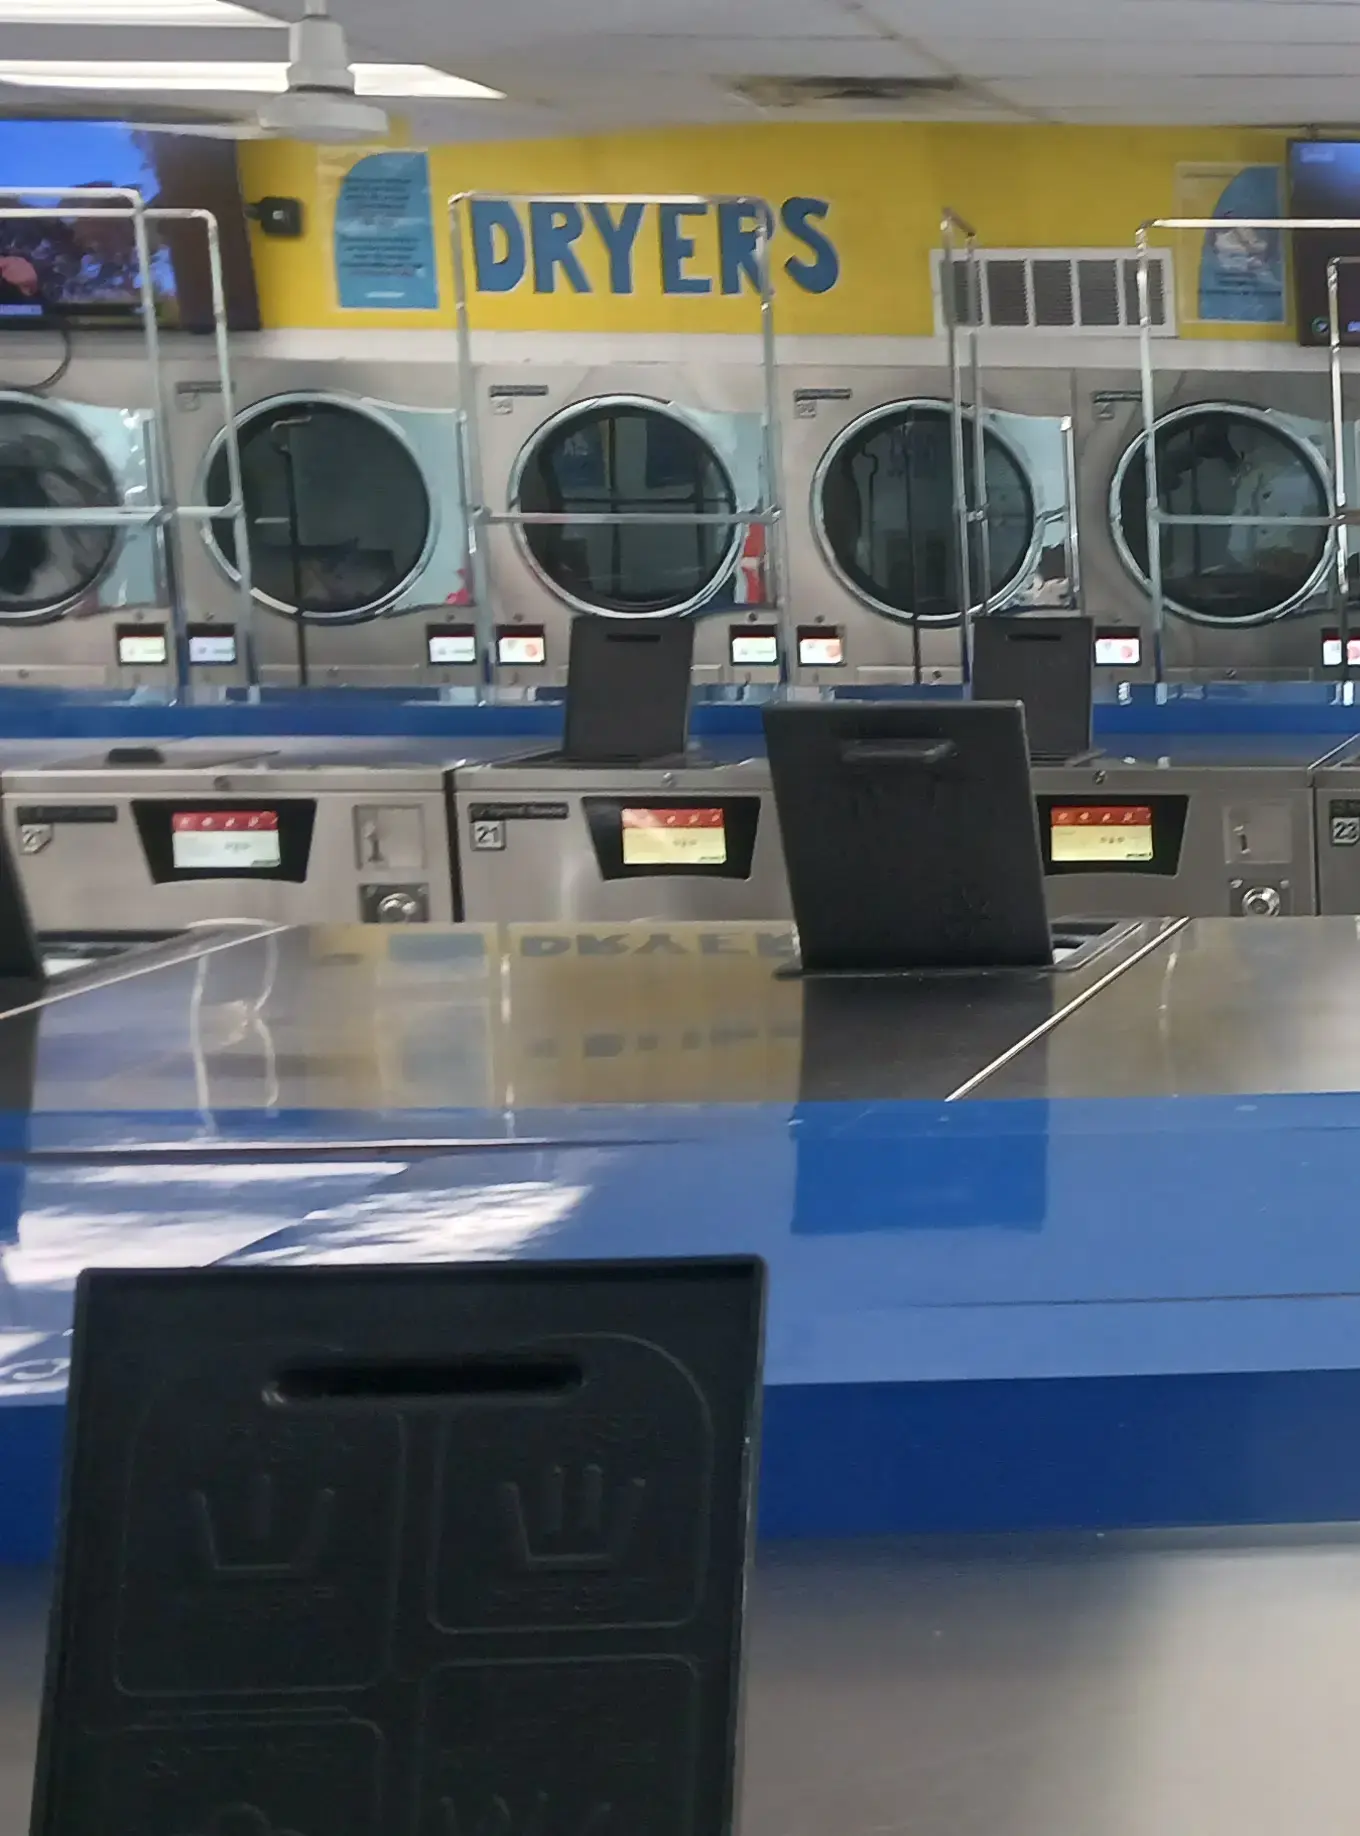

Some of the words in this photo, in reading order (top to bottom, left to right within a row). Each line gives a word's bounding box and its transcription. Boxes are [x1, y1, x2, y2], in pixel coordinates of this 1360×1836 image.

[470, 196, 839, 295] DRYERS
[476, 825, 499, 843] 21
[1334, 820, 1358, 840] 23
